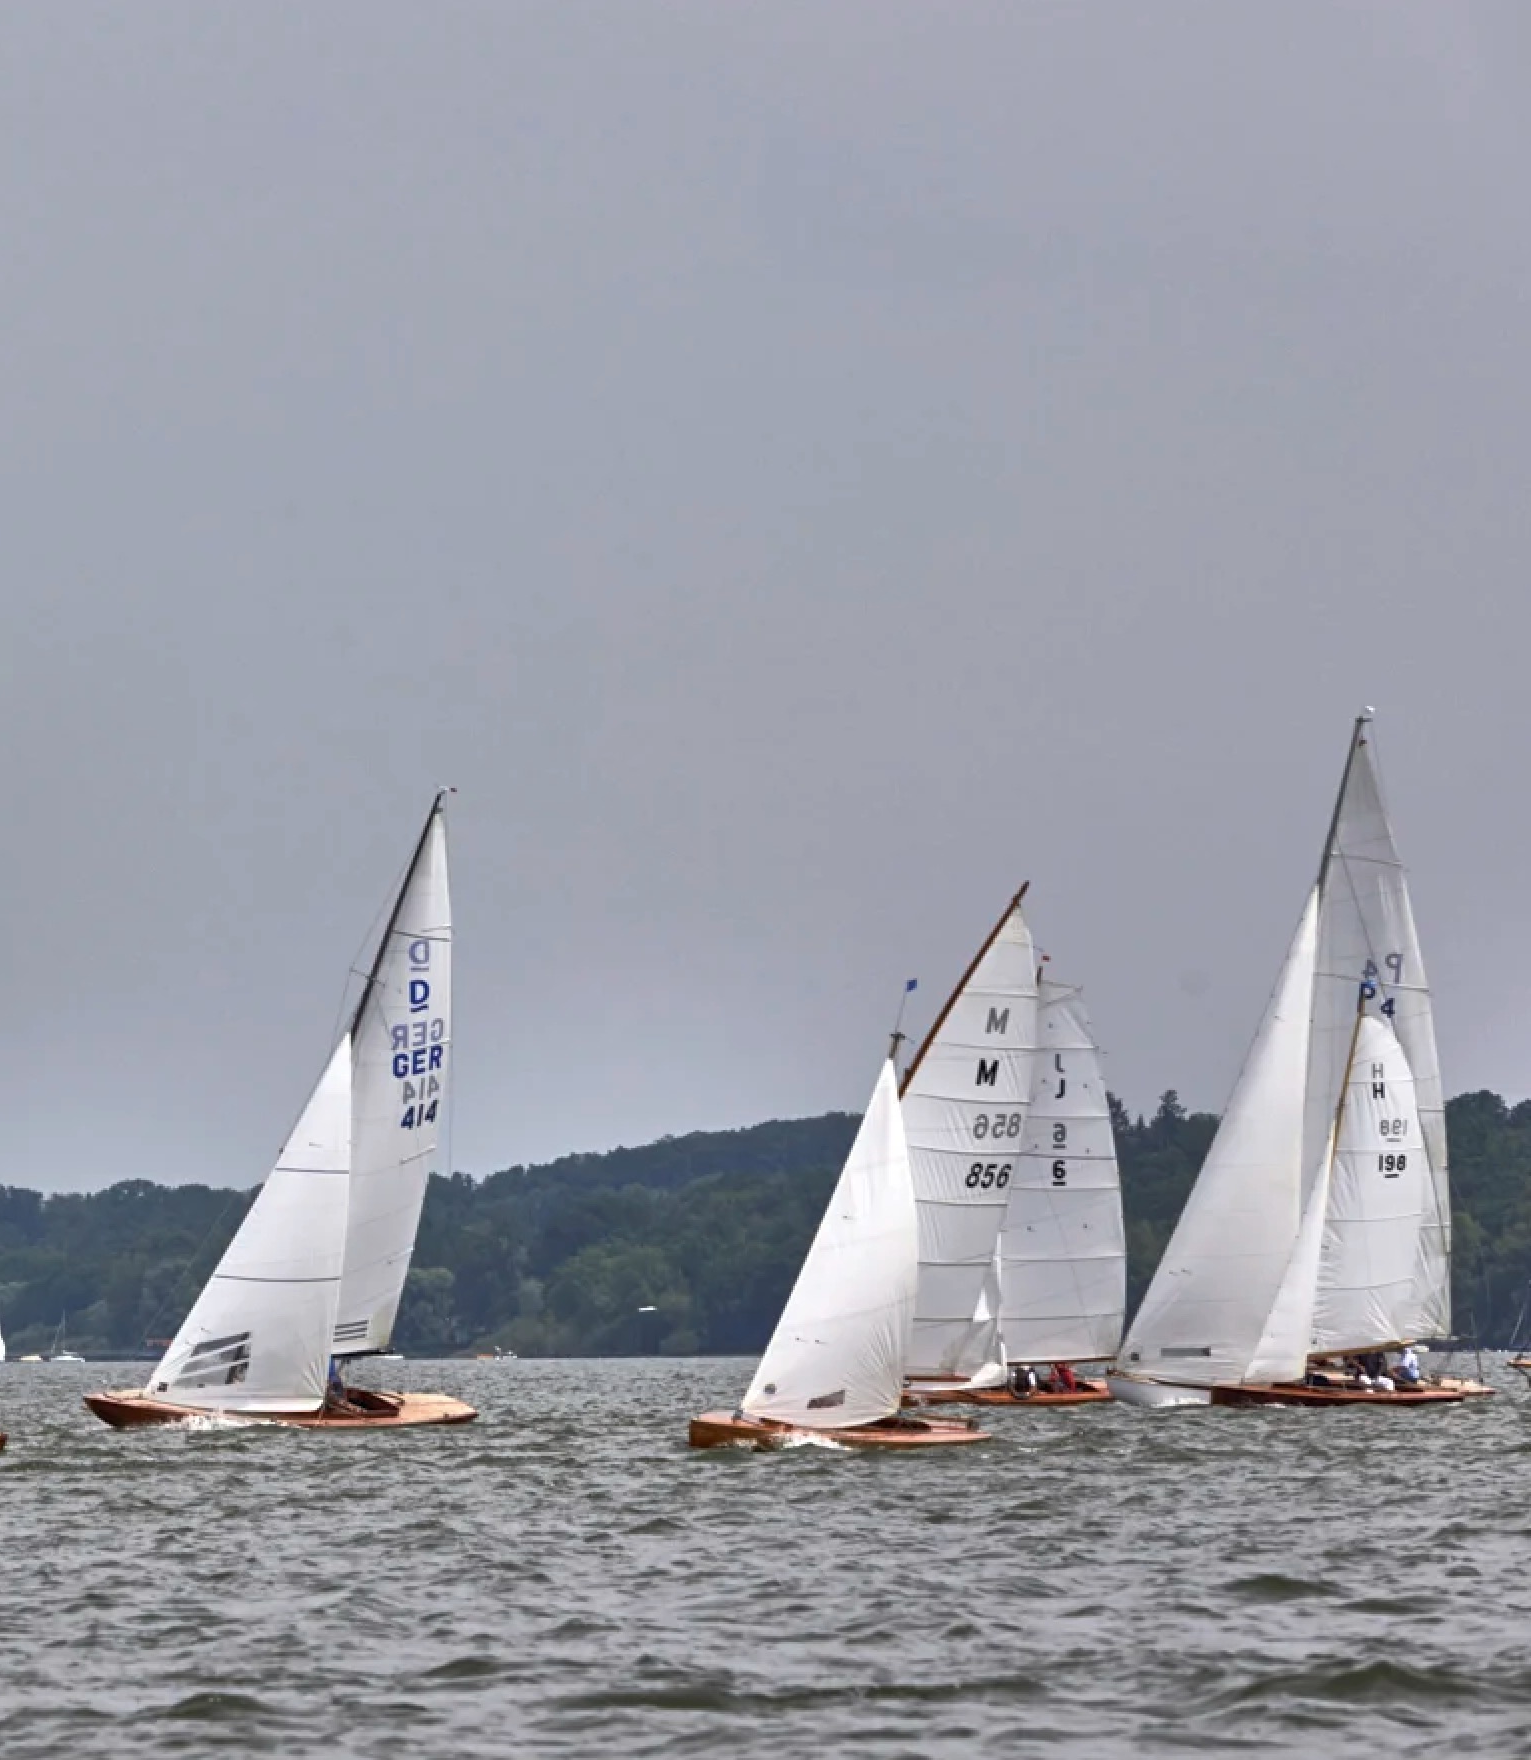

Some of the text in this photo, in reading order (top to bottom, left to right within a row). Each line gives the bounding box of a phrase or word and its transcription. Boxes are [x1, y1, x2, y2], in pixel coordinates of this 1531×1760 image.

[408, 979, 431, 1006] D
[1380, 998, 1395, 1018] 4
[985, 1007, 1010, 1034] M
[393, 1044, 443, 1078] GER
[975, 1058, 1000, 1086] M
[1372, 1062, 1384, 1079] H
[1054, 1078, 1066, 1099] J
[1372, 1081, 1386, 1100] H
[400, 1098, 440, 1130] 414
[1052, 1159, 1067, 1180] 6
[1378, 1154, 1407, 1172] 198
[965, 1162, 1012, 1190] 856
